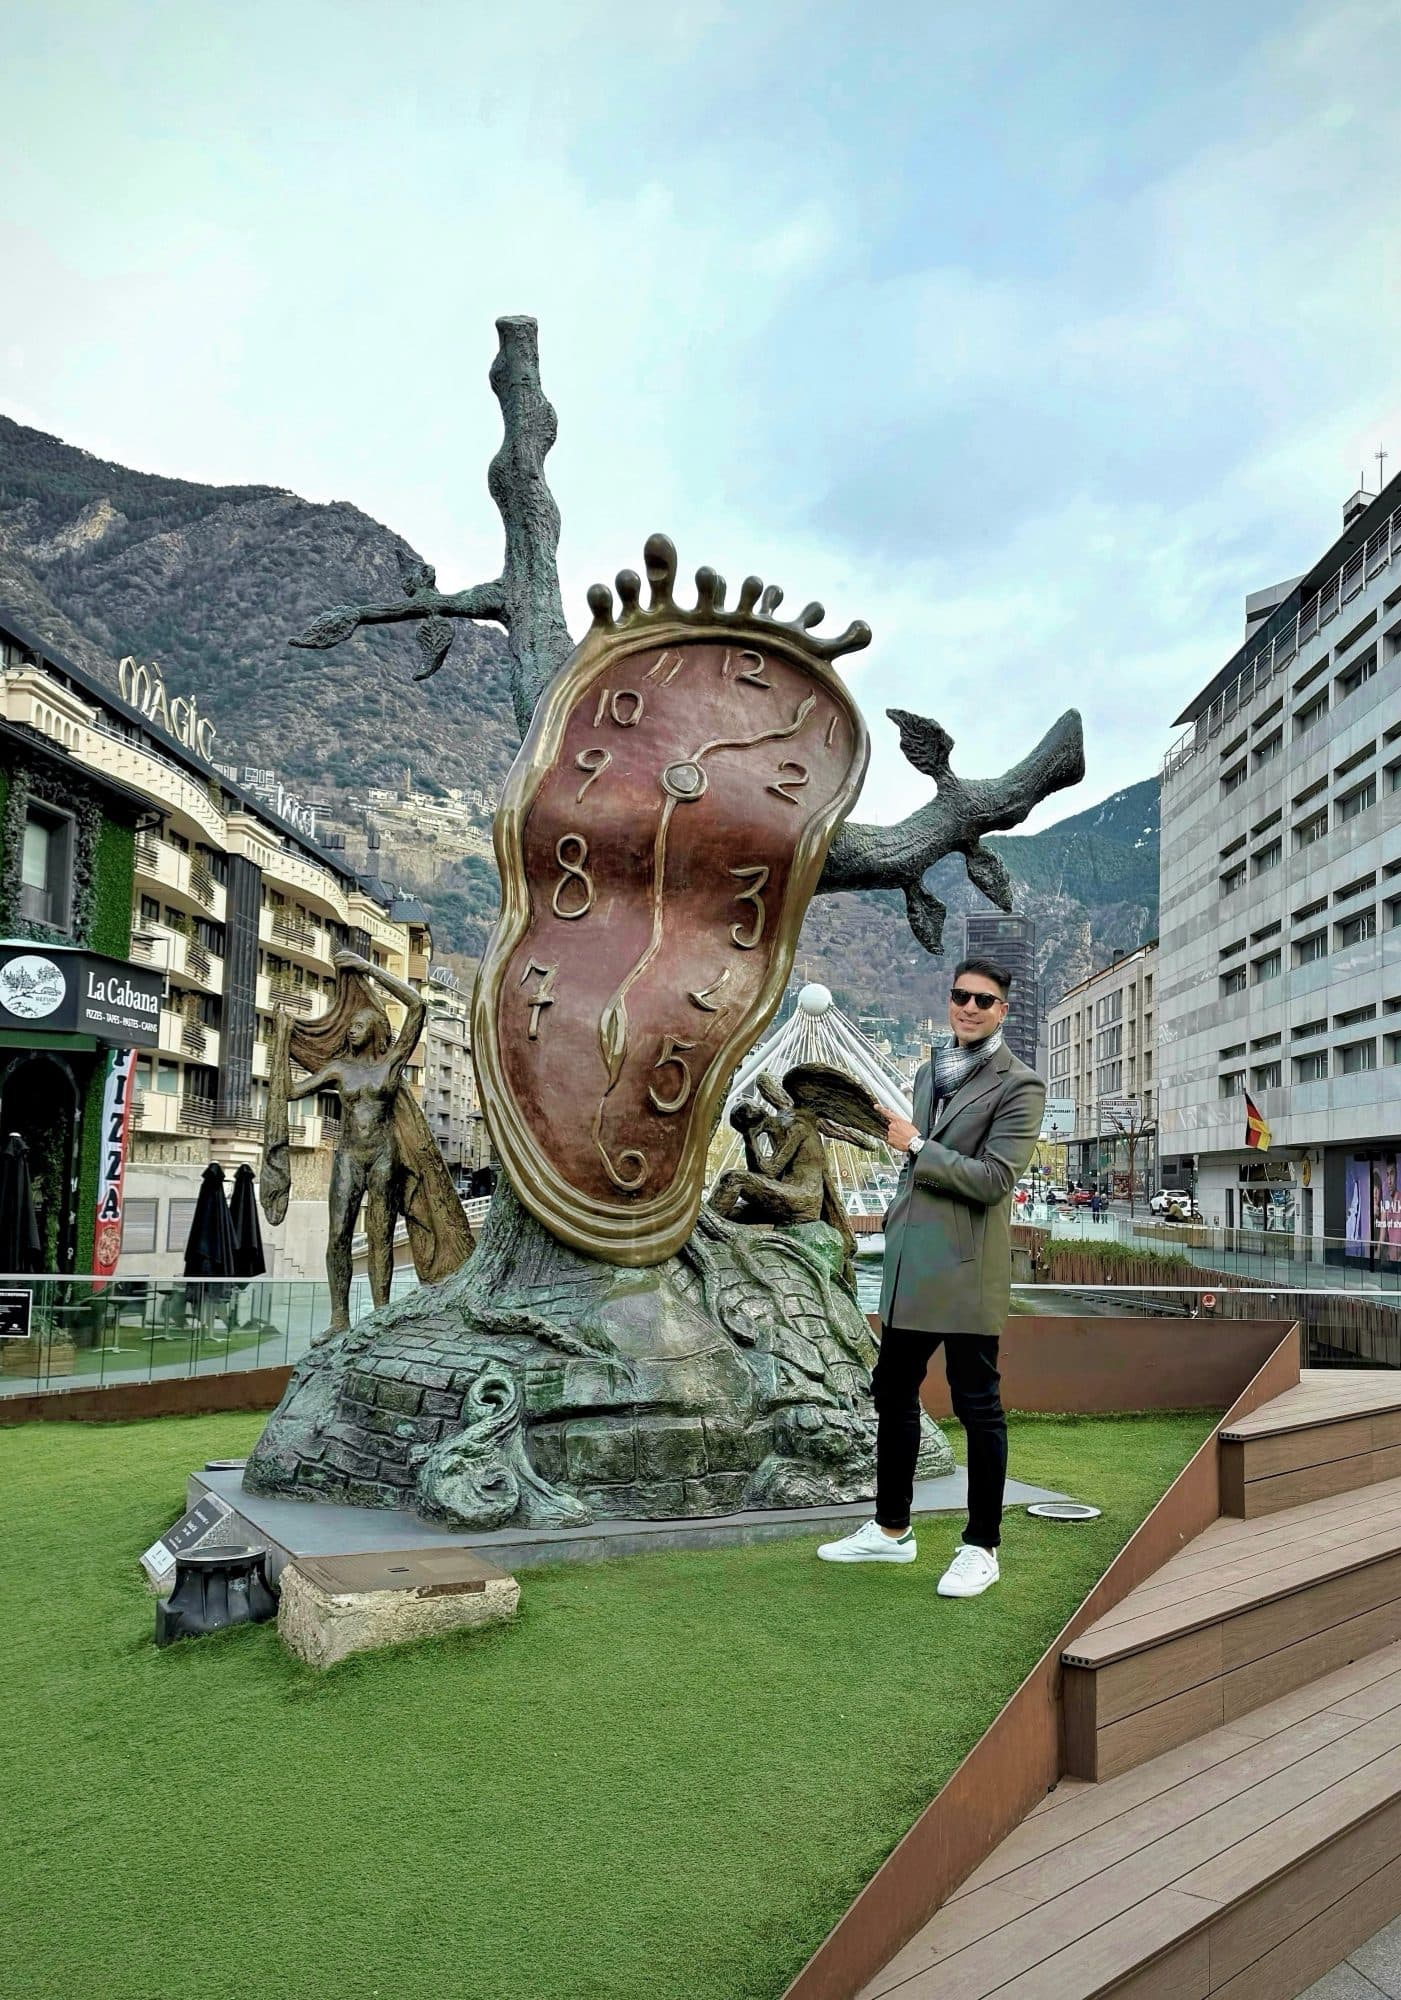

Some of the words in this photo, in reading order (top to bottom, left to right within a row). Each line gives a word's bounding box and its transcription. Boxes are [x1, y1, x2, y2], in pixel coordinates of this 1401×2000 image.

[722, 649, 772, 689] 12
[593, 688, 644, 727] 10
[575, 747, 612, 804] 9
[764, 759, 810, 805] 2
[552, 833, 594, 919] 8
[729, 866, 769, 949] 3
[87, 971, 105, 1002] La
[107, 977, 158, 1014] Cabana
[520, 958, 558, 1041] 7
[649, 1033, 698, 1113] 5
[592, 1097, 649, 1192] 6
